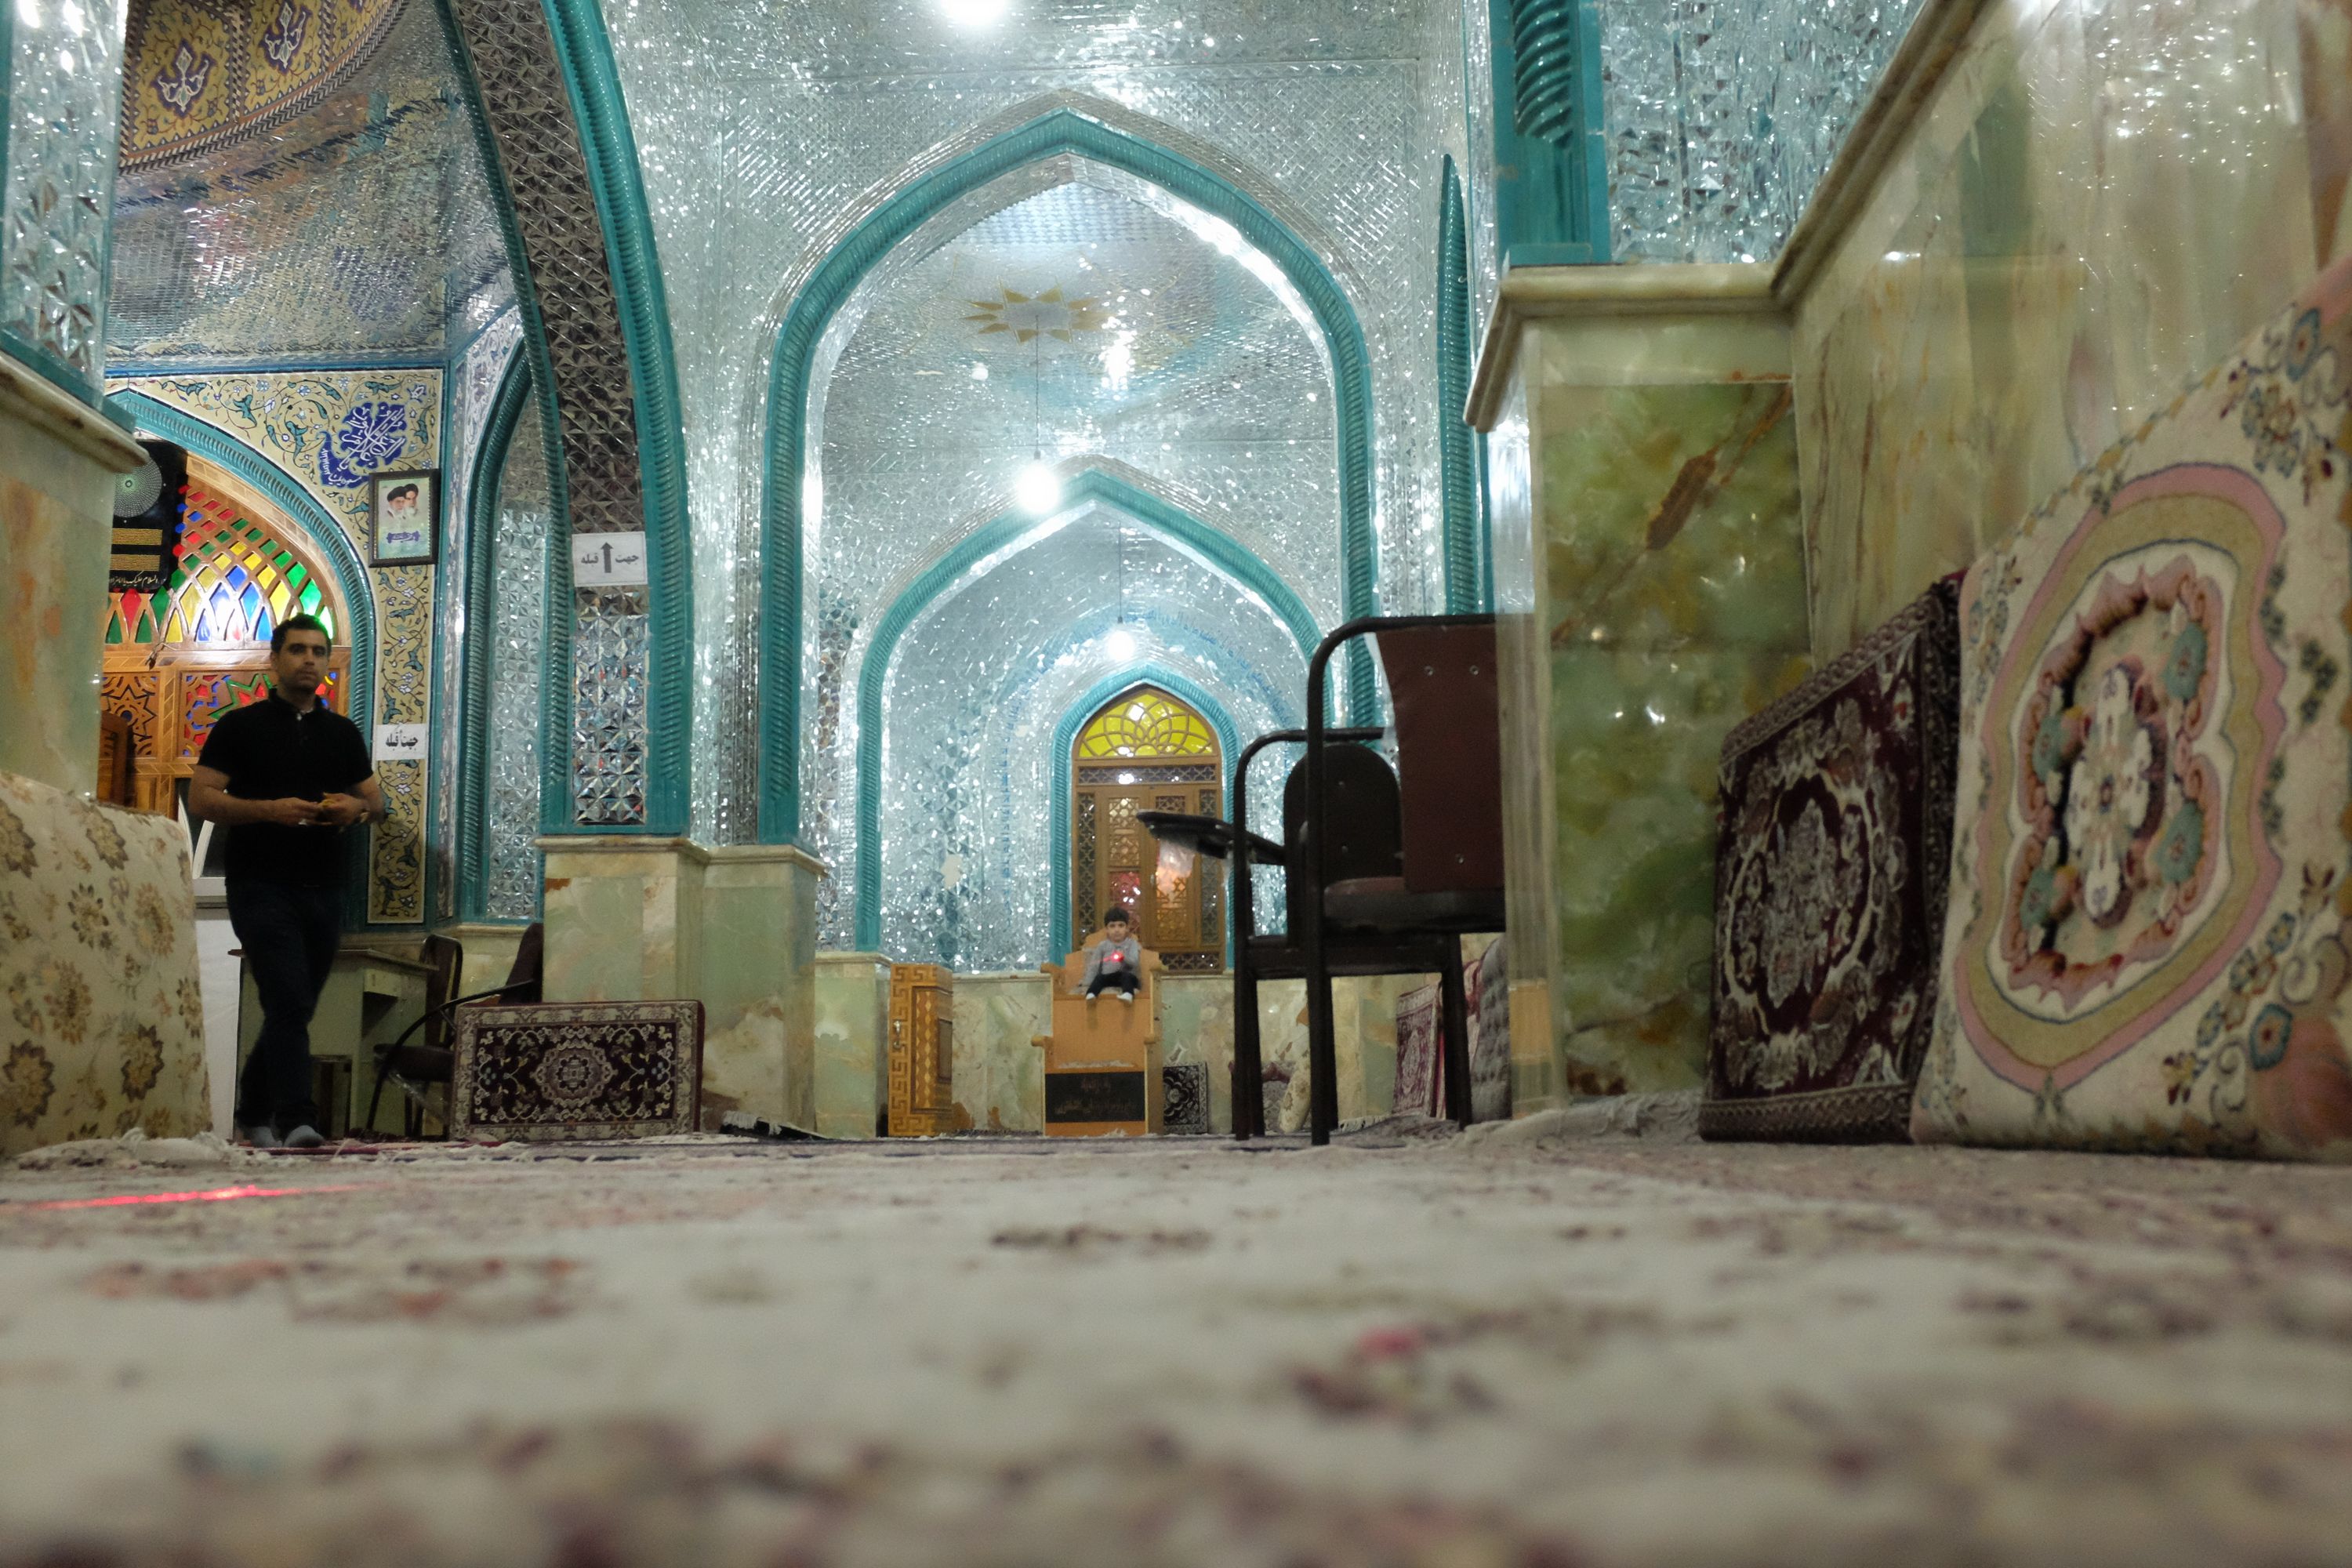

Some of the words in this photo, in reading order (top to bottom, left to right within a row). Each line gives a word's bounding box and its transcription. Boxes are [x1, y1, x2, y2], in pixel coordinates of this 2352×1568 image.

[581, 552, 599, 567] قبله
[615, 554, 639, 565] جهت
[385, 732, 398, 751] قبله
[401, 735, 419, 751] جهت
